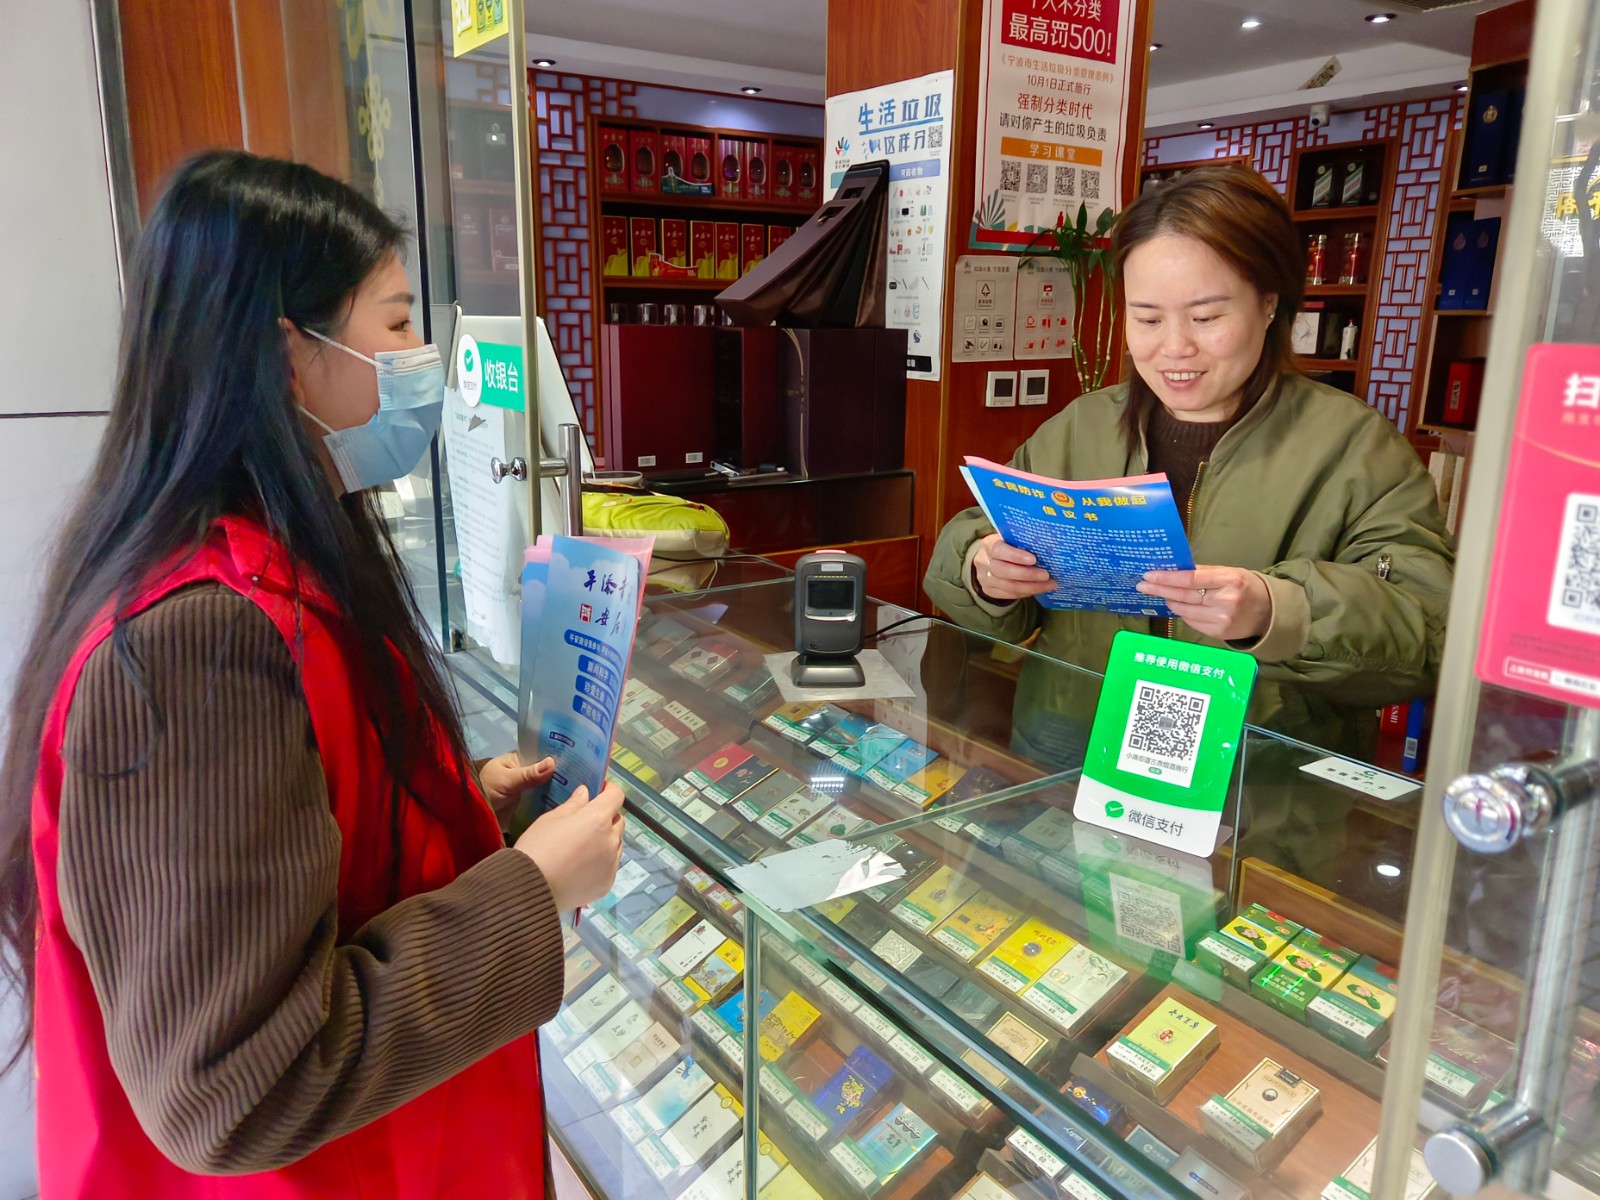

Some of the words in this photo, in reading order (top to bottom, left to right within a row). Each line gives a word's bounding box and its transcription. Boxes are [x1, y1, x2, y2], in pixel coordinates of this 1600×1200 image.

[1008, 12, 1112, 57] 最高罚500!
[1026, 74, 1092, 96] 10月1日正式施行
[858, 93, 942, 131] 生活垃圾
[1017, 93, 1093, 120] 强制分类时代
[999, 112, 1108, 142] 请对你产生的垃圾负责
[1029, 143, 1076, 160] 学习课堂
[484, 358, 519, 393] 收银台
[1133, 651, 1226, 680] 推荐使用微信支付
[1128, 809, 1184, 837] 微信支付
